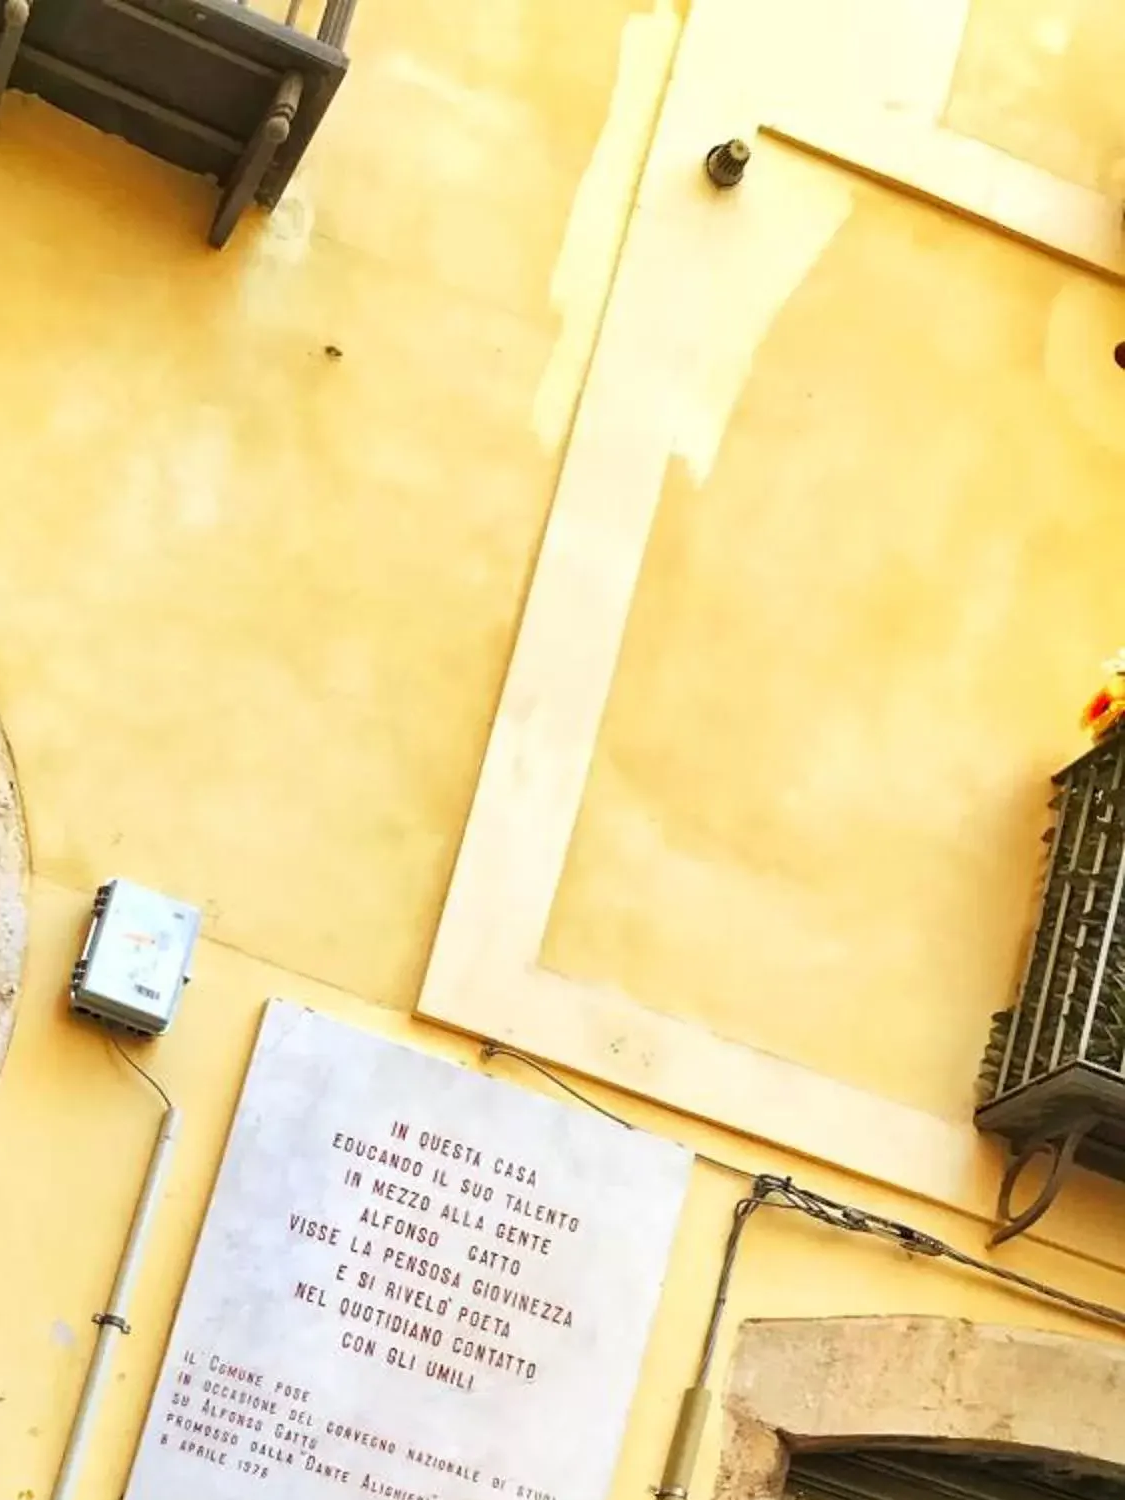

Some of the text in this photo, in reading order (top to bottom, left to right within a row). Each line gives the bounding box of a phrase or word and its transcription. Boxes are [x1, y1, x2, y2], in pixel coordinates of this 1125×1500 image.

[332, 1133, 580, 1233] EDUCANDO IL SUO TALENTO
[391, 1121, 537, 1188] IN QUESTA CASA
[343, 1169, 552, 1255] IN MEZZO ALLA GENTE
[359, 1208, 522, 1276] ALFONSO GATTO
[289, 1213, 573, 1328] VISSE LA PENSOSA GIOVINEZZA
[336, 1264, 348, 1281] E
[358, 1271, 376, 1290] SI
[458, 1307, 511, 1338] POETA
[294, 1282, 537, 1380] NEL QUOTIDIANO CONTATTO
[341, 1331, 475, 1391] CON GLI UMILI
[171, 1393, 191, 1407] SU
[183, 1350, 196, 1365] IL
[274, 1381, 311, 1403] POSE
[178, 1371, 192, 1386] IN
[203, 1380, 276, 1415] OCCASIONE
[288, 1409, 314, 1427] DEL
[326, 1421, 396, 1455] CONVEGNO
[406, 1448, 480, 1484] NAZIONALE
[492, 1477, 506, 1491] DI
[179, 1440, 227, 1466] APRILE
[250, 1441, 294, 1465] DALLA
